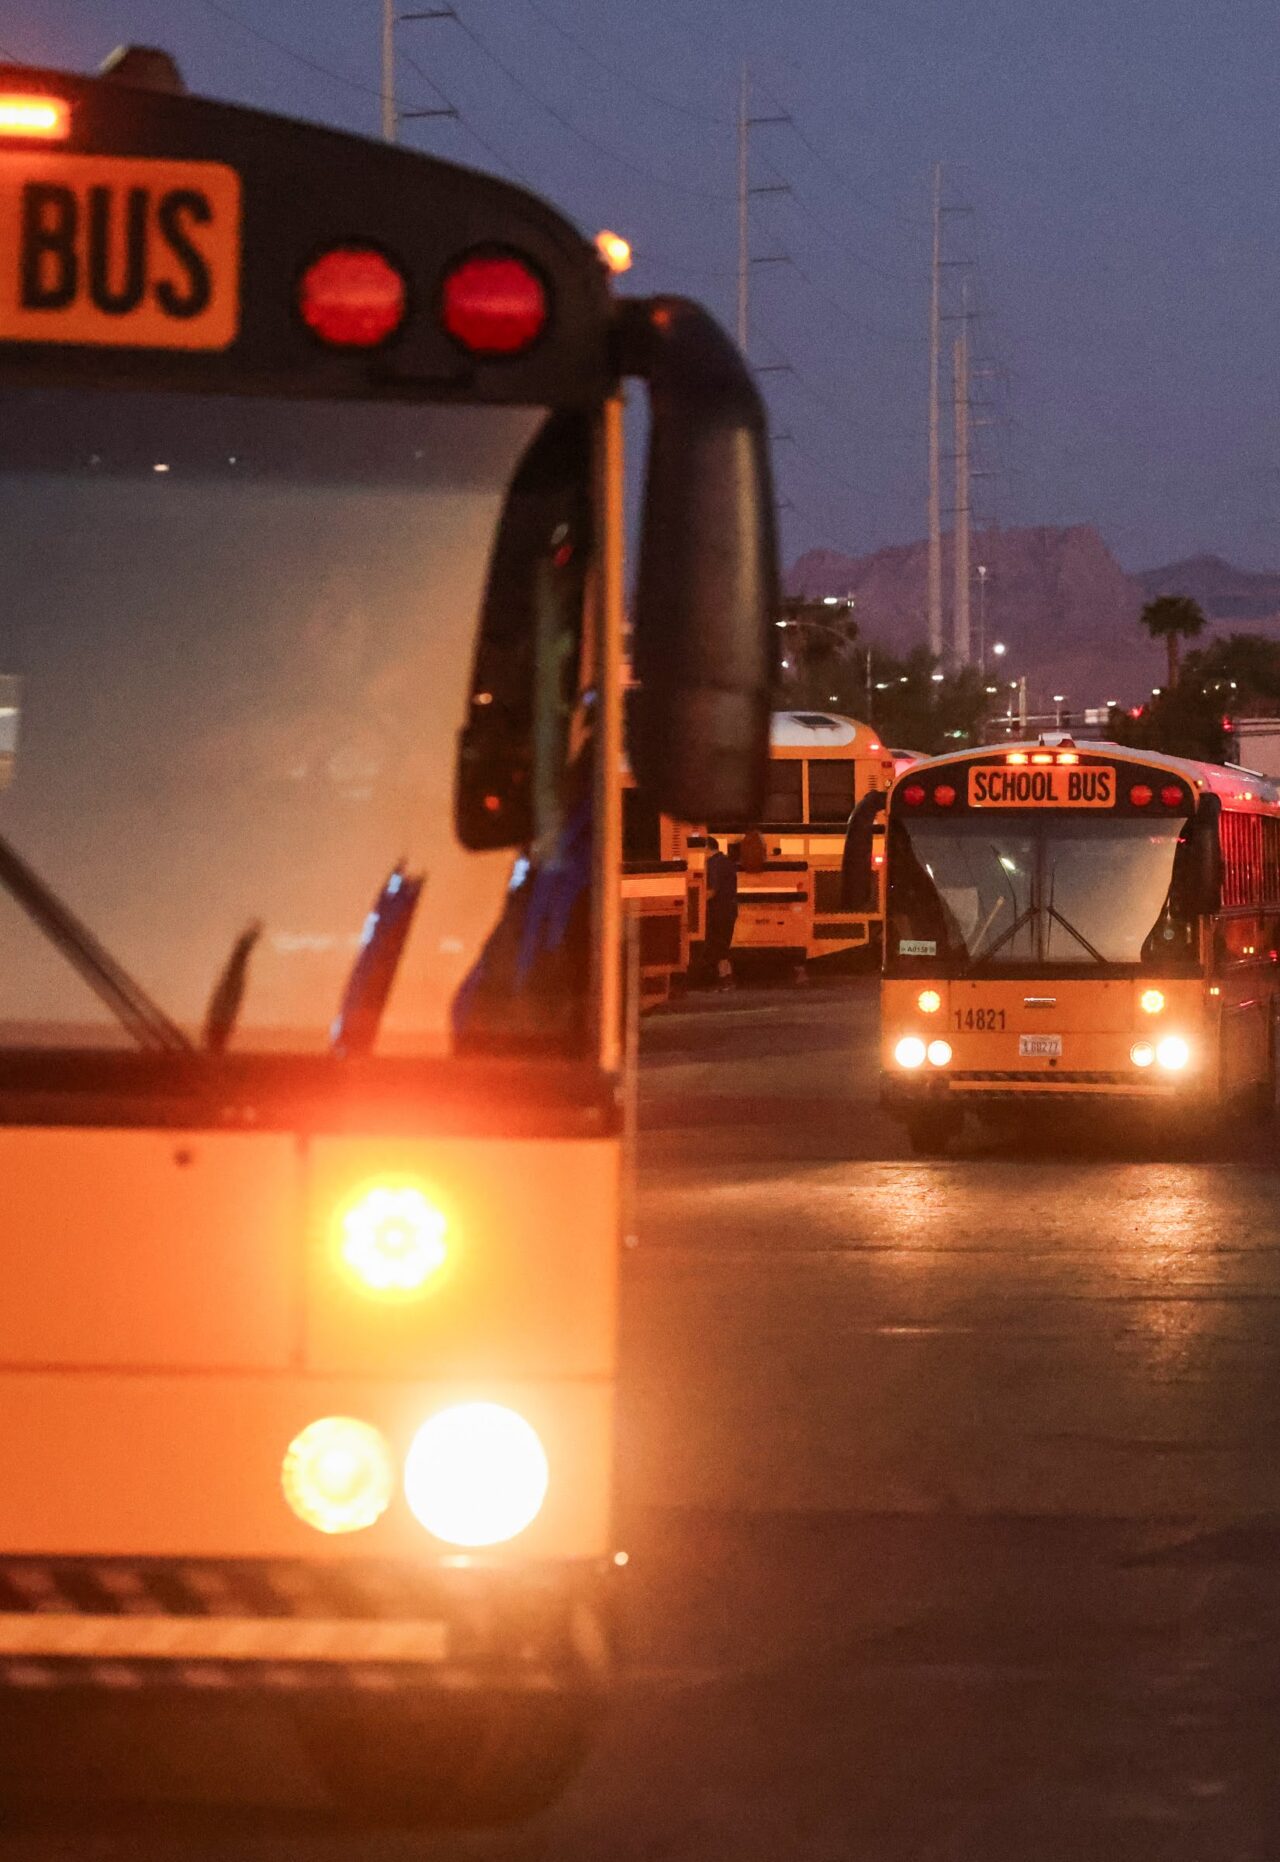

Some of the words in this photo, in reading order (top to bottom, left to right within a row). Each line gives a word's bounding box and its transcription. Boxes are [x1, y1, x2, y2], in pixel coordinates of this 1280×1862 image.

[20, 180, 212, 320] BUS
[974, 771, 1059, 802] SCHOOL
[1068, 772, 1111, 802] BUS
[954, 1009, 1006, 1031] 14821
